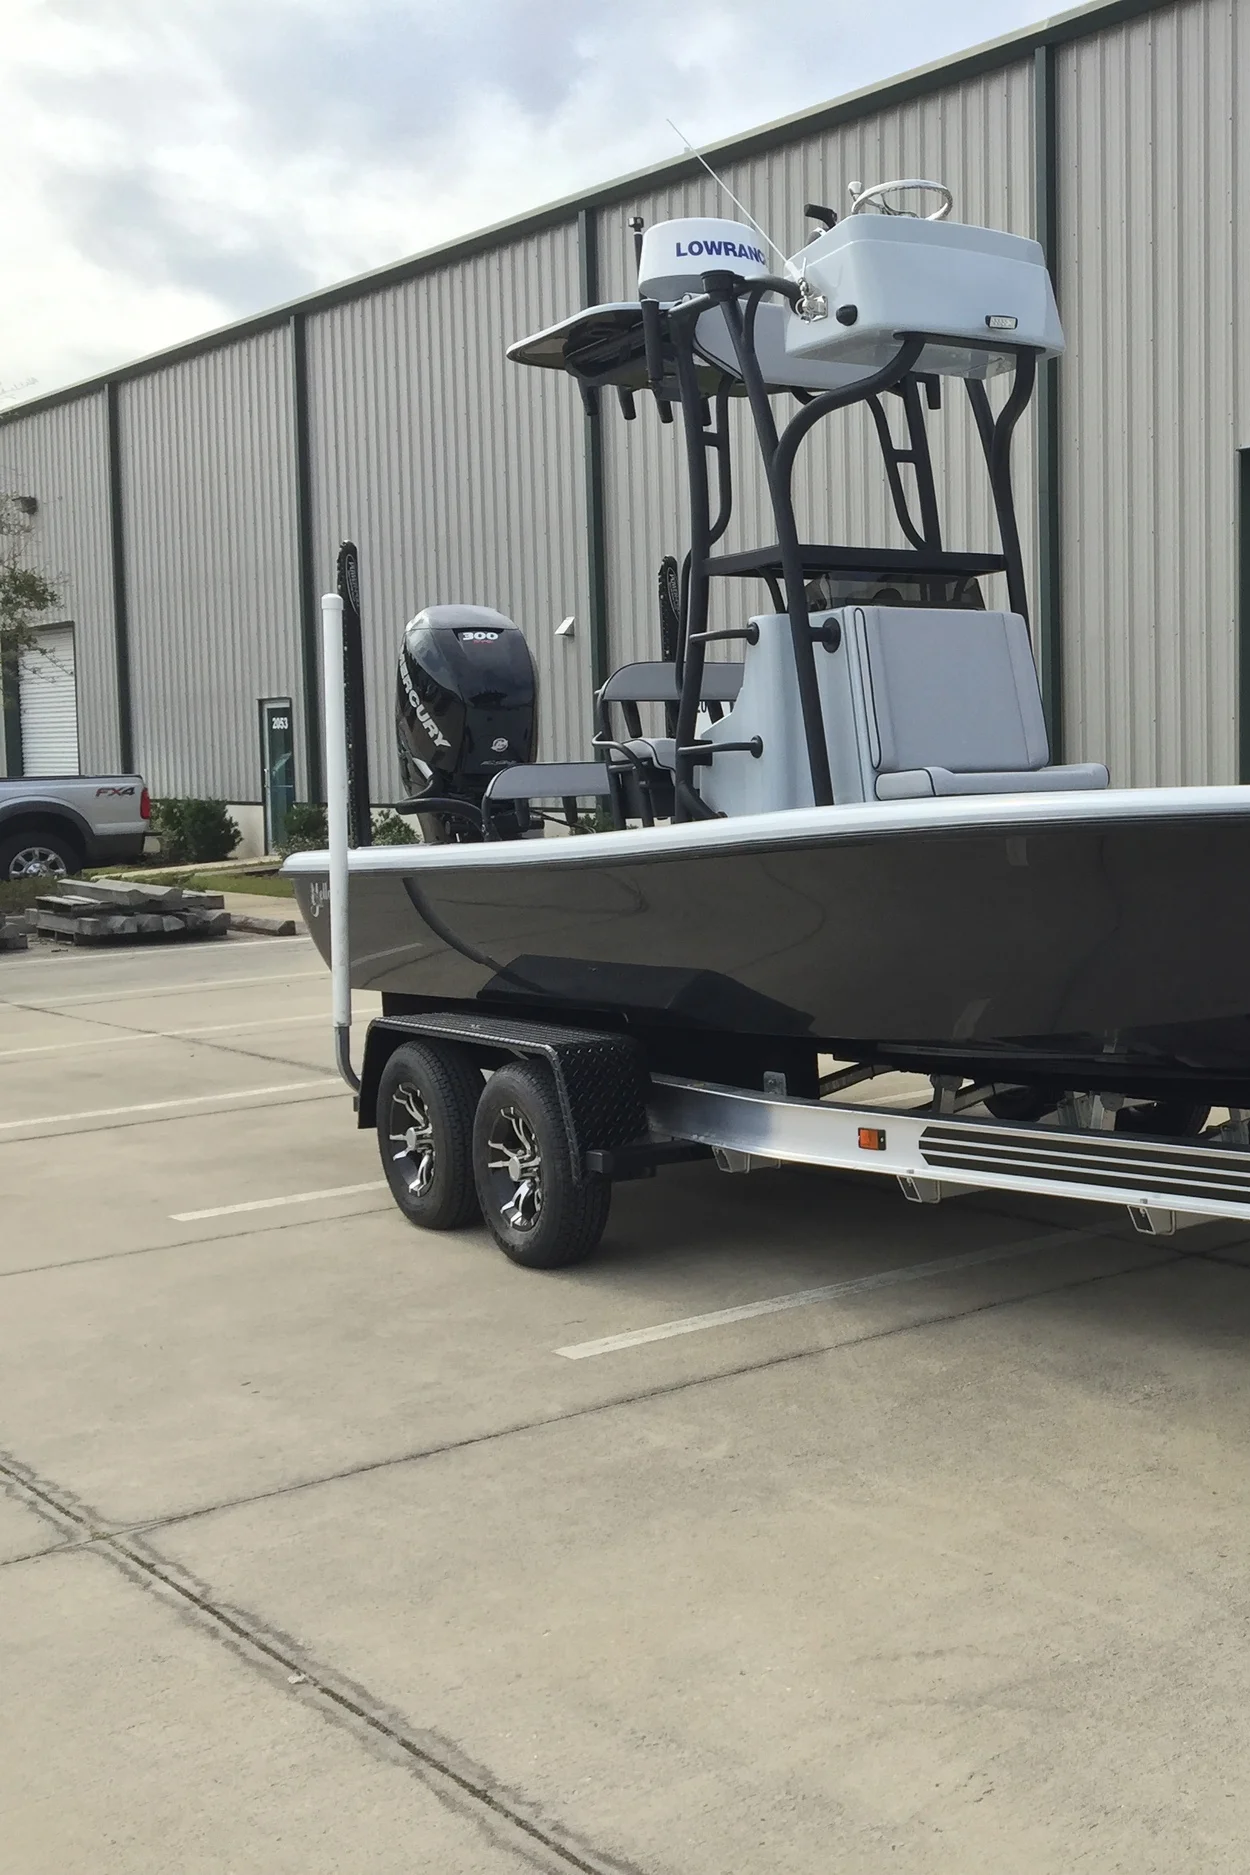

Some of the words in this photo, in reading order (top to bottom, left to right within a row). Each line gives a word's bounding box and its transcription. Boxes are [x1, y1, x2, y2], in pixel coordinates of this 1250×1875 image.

[676, 241, 767, 266] LOWRANC
[462, 632, 499, 641] 300
[95, 787, 135, 797] FX4
